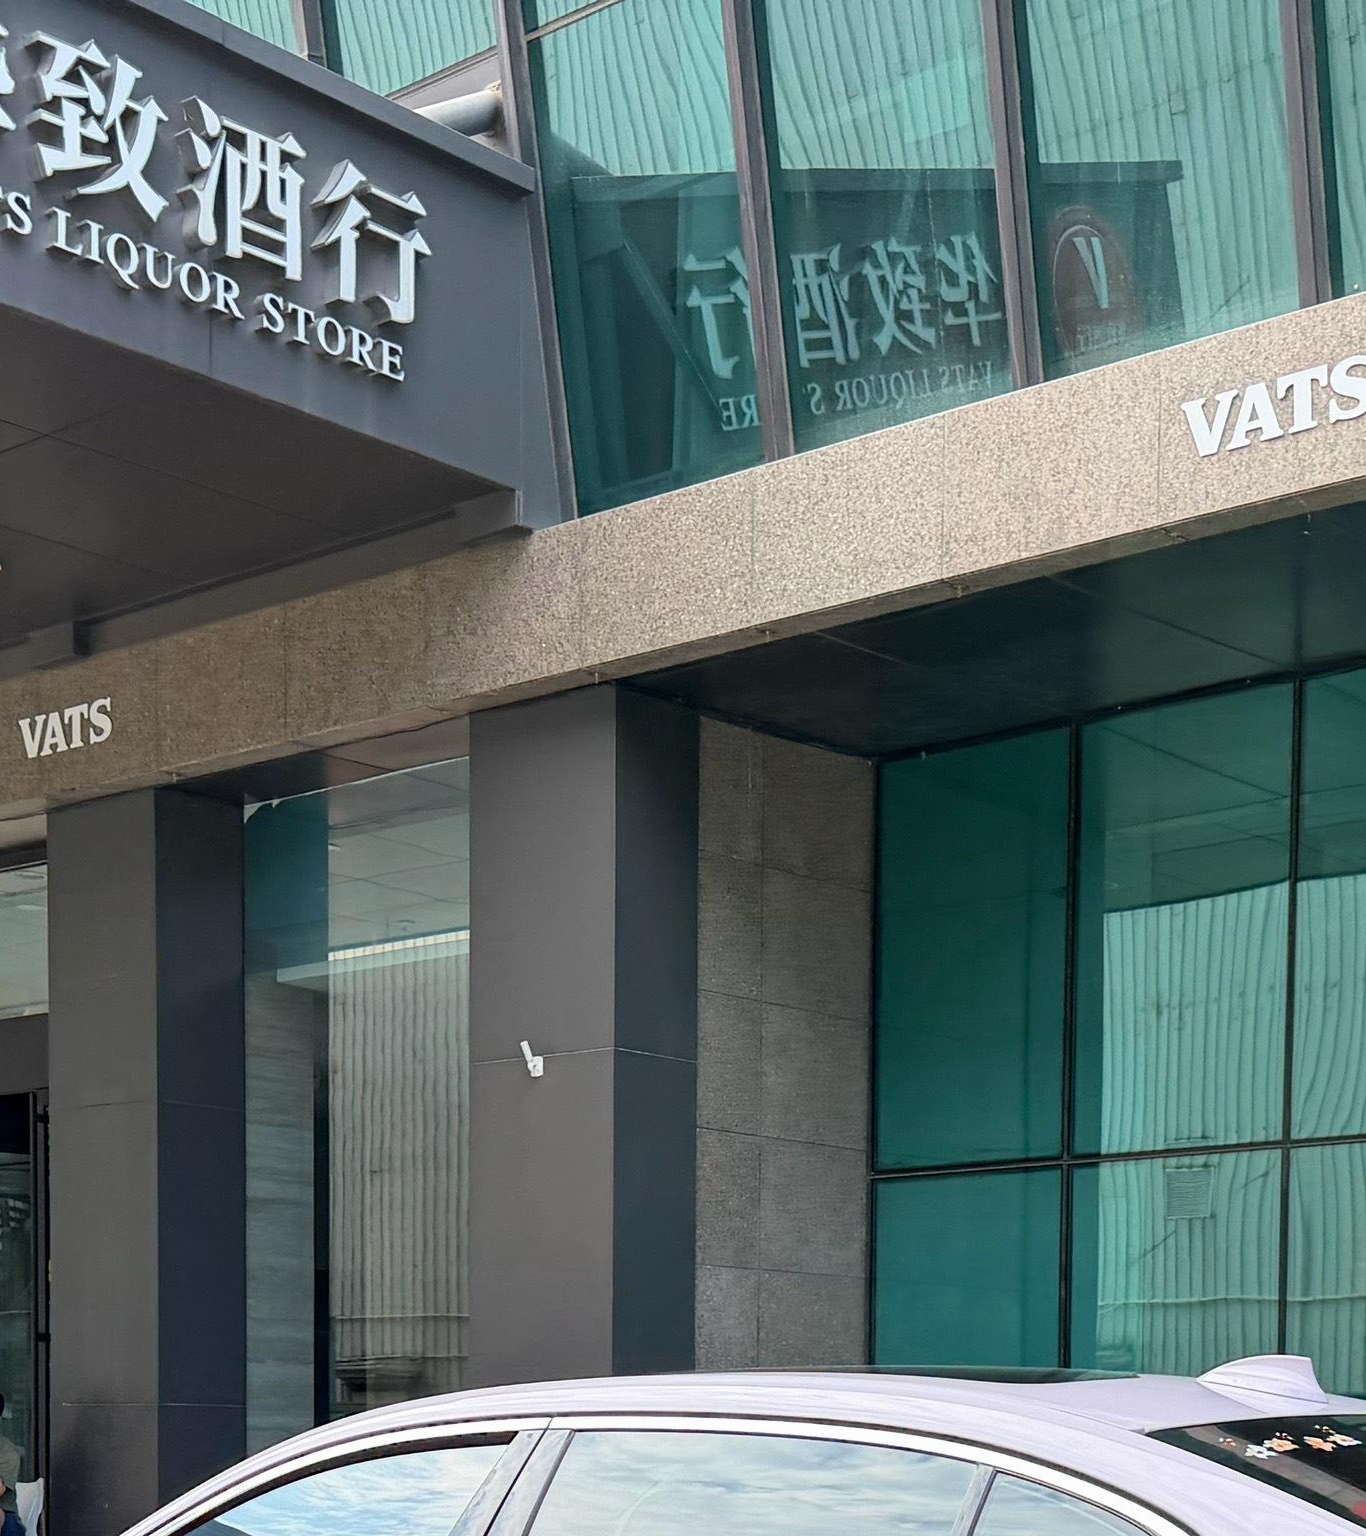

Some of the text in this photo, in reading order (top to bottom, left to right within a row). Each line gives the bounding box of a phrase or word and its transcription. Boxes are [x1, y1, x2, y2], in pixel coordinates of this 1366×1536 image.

[51, 209, 245, 321] LIQUOR
[260, 294, 406, 382] STORE
[18, 697, 114, 760] VATS
